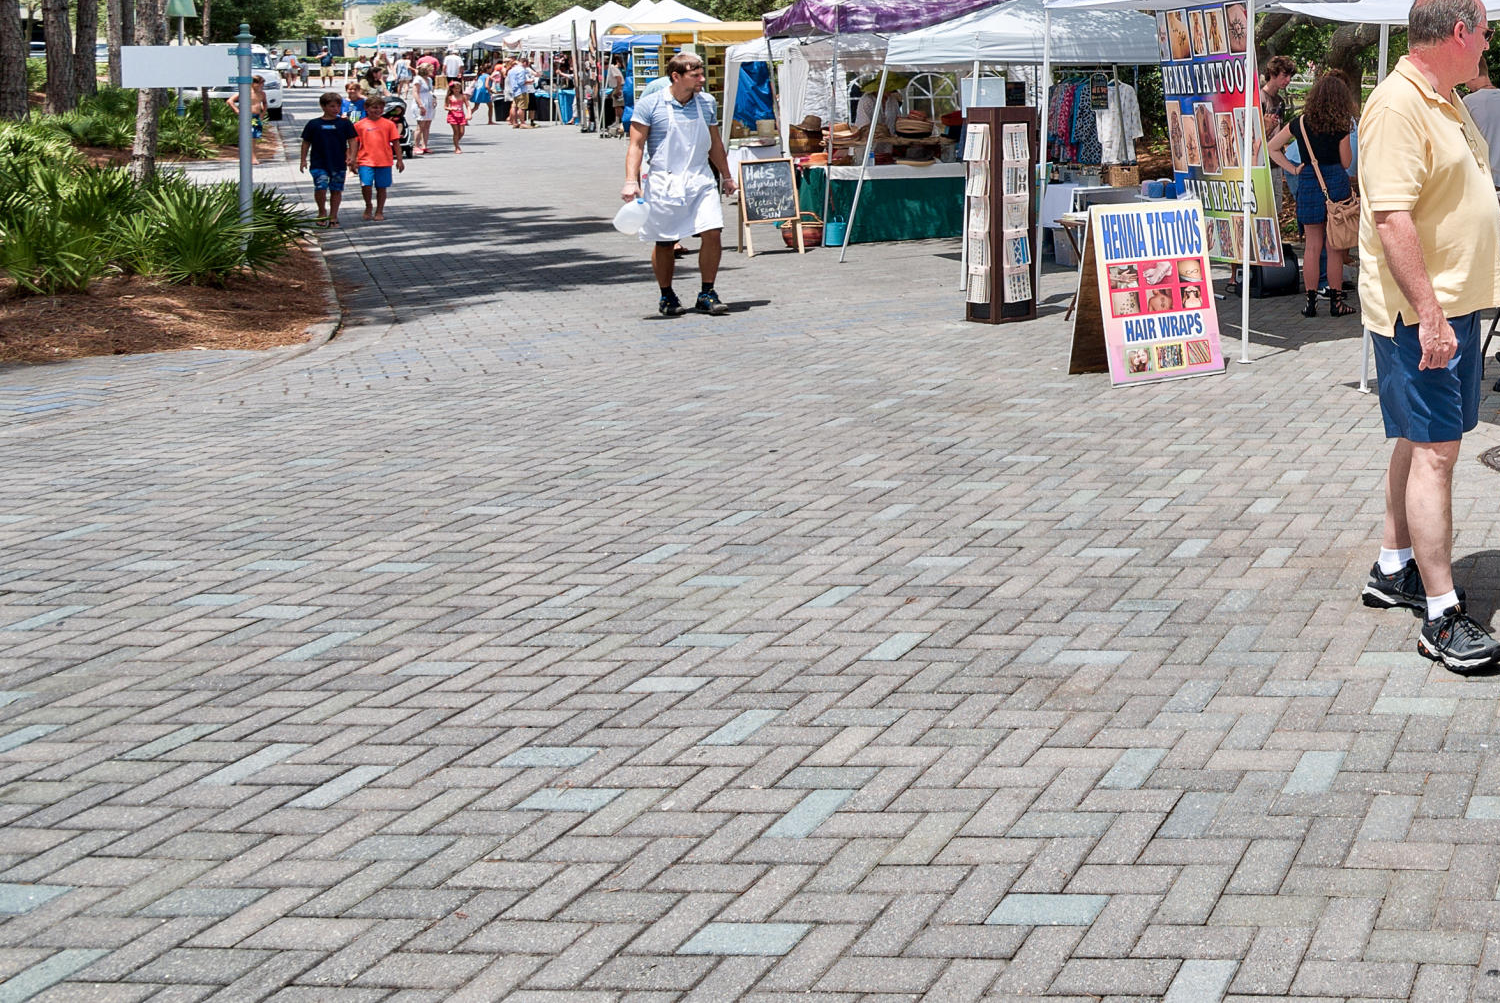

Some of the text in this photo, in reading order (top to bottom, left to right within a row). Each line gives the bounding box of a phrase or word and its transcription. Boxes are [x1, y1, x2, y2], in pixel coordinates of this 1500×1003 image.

[1162, 59, 1247, 95] HENNA TATTOO
[1101, 208, 1202, 260] HENNA TATTOOS
[1125, 312, 1203, 343] HAIR WRAPS
